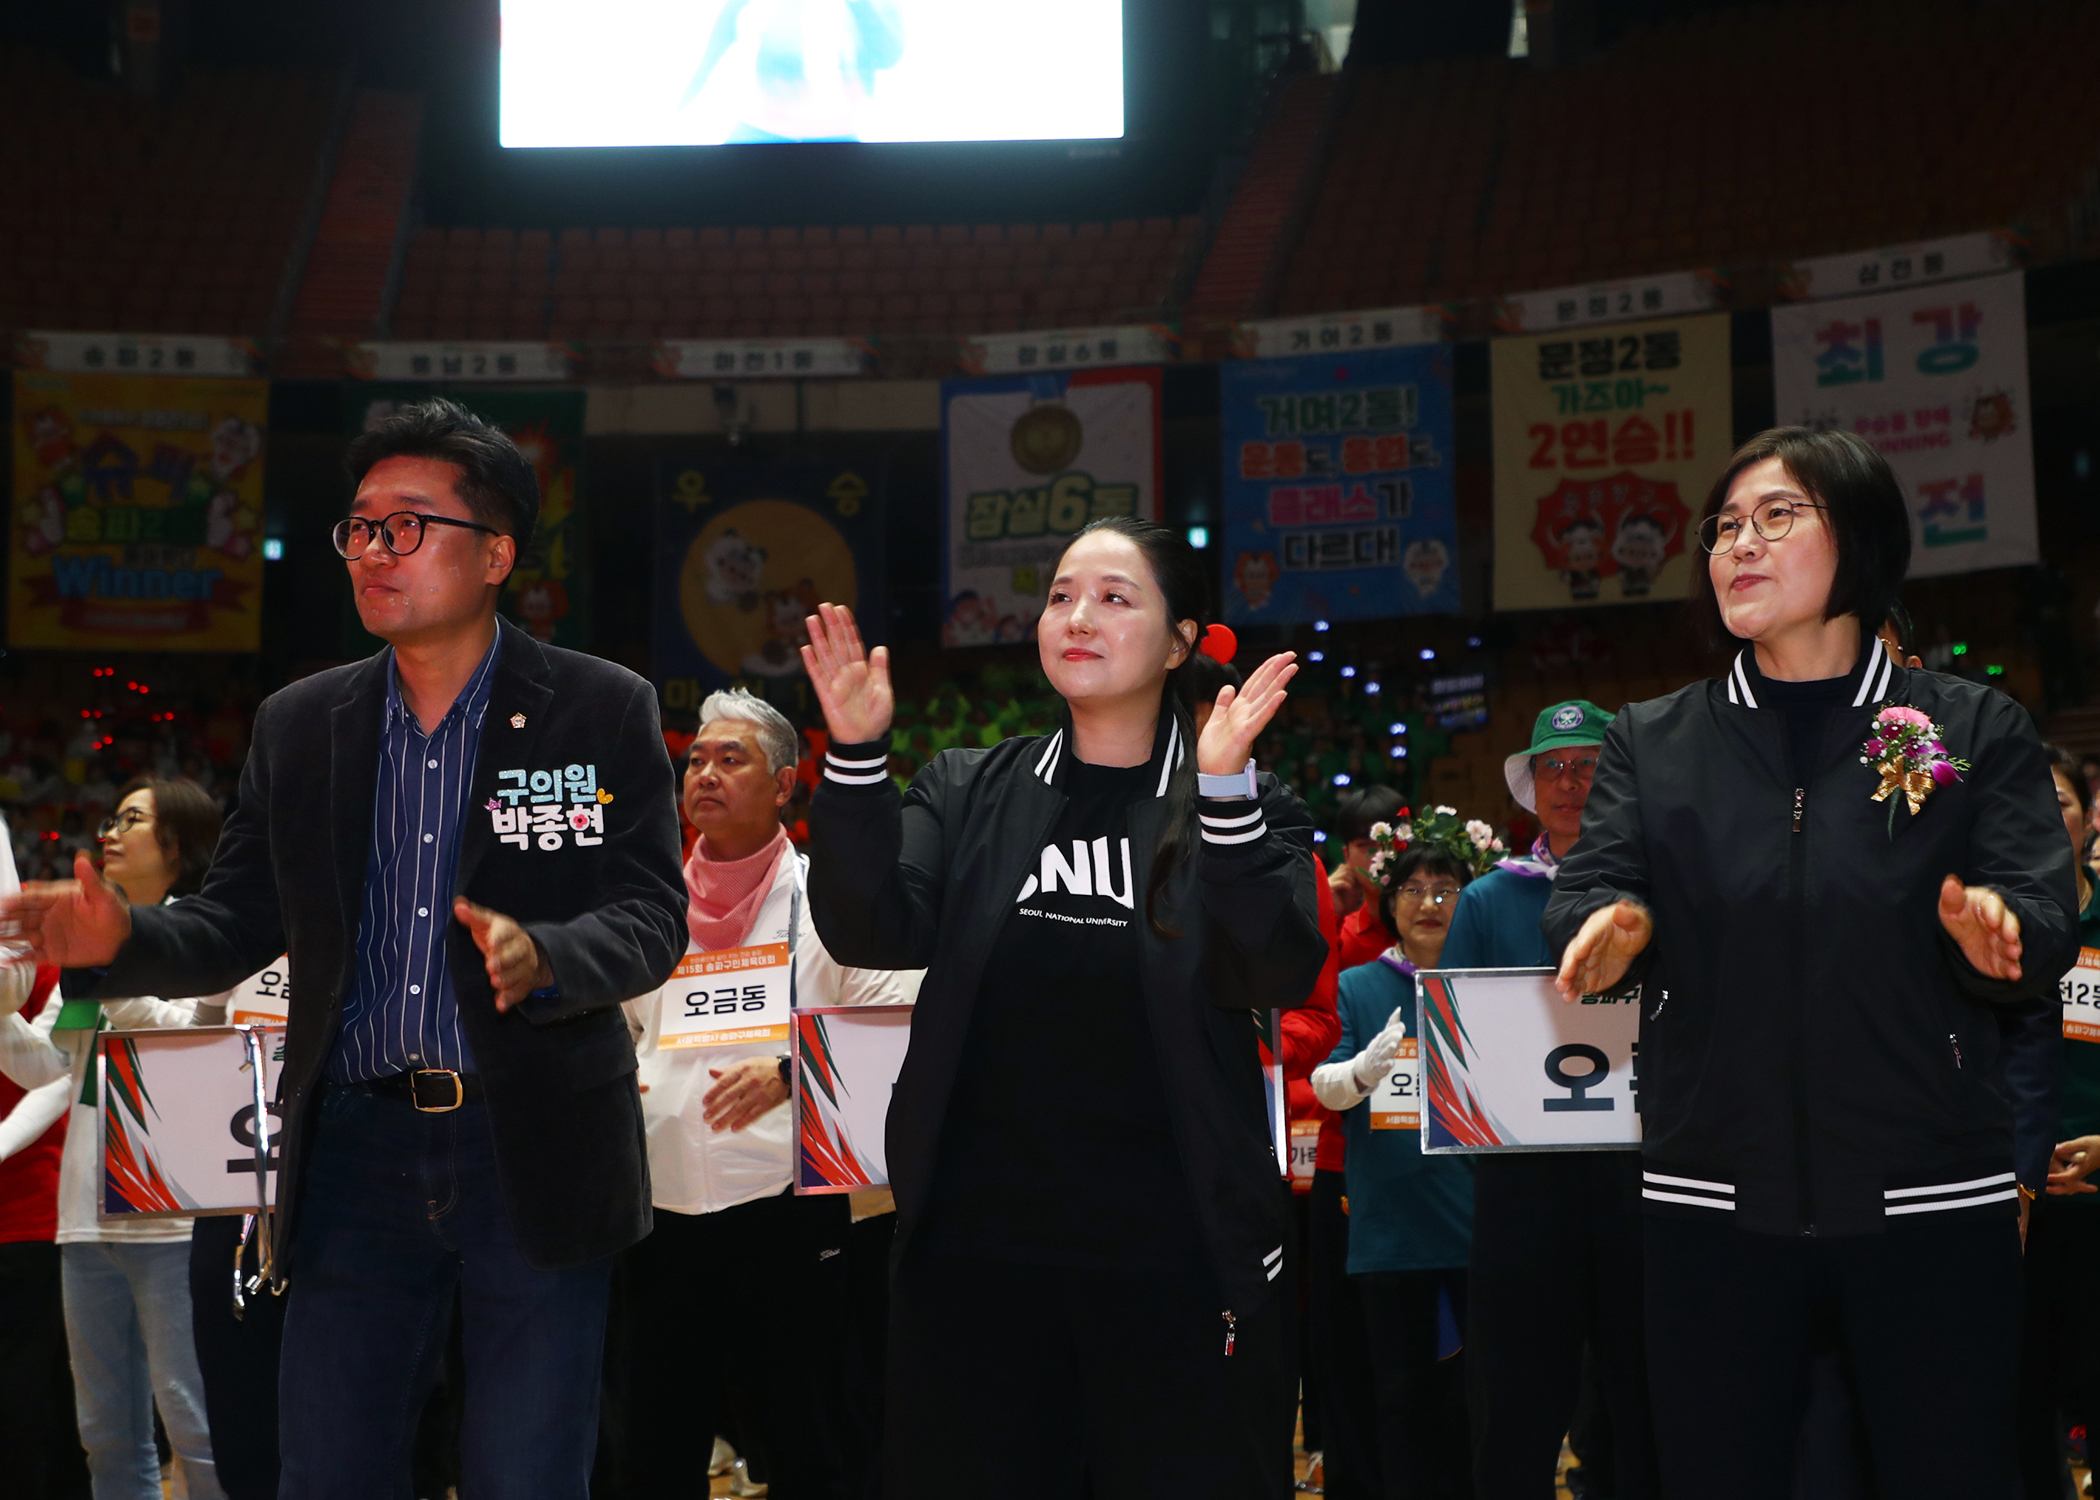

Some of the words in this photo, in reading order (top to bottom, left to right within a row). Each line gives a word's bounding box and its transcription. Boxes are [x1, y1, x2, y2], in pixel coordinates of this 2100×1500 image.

[1538, 330, 1682, 381] 문정2동
[1815, 317, 1885, 387] 최
[1911, 302, 1983, 377] 강
[1258, 383, 1419, 437] 거여2동!
[1528, 408, 1696, 470] 2연승!!
[52, 554, 225, 601] Winner
[497, 764, 597, 806] 구의원
[491, 803, 605, 851] 박종현
[1018, 907, 1044, 918] SEOUL
[1045, 911, 1085, 925] NATIONAL
[1085, 916, 1129, 928] UNIVERSITY
[255, 970, 290, 1000] 오
[677, 964, 704, 976] 제15회
[705, 954, 777, 973] 송파구민체육대회
[684, 984, 767, 1017] 오금동
[1542, 1042, 1641, 1113] 오
